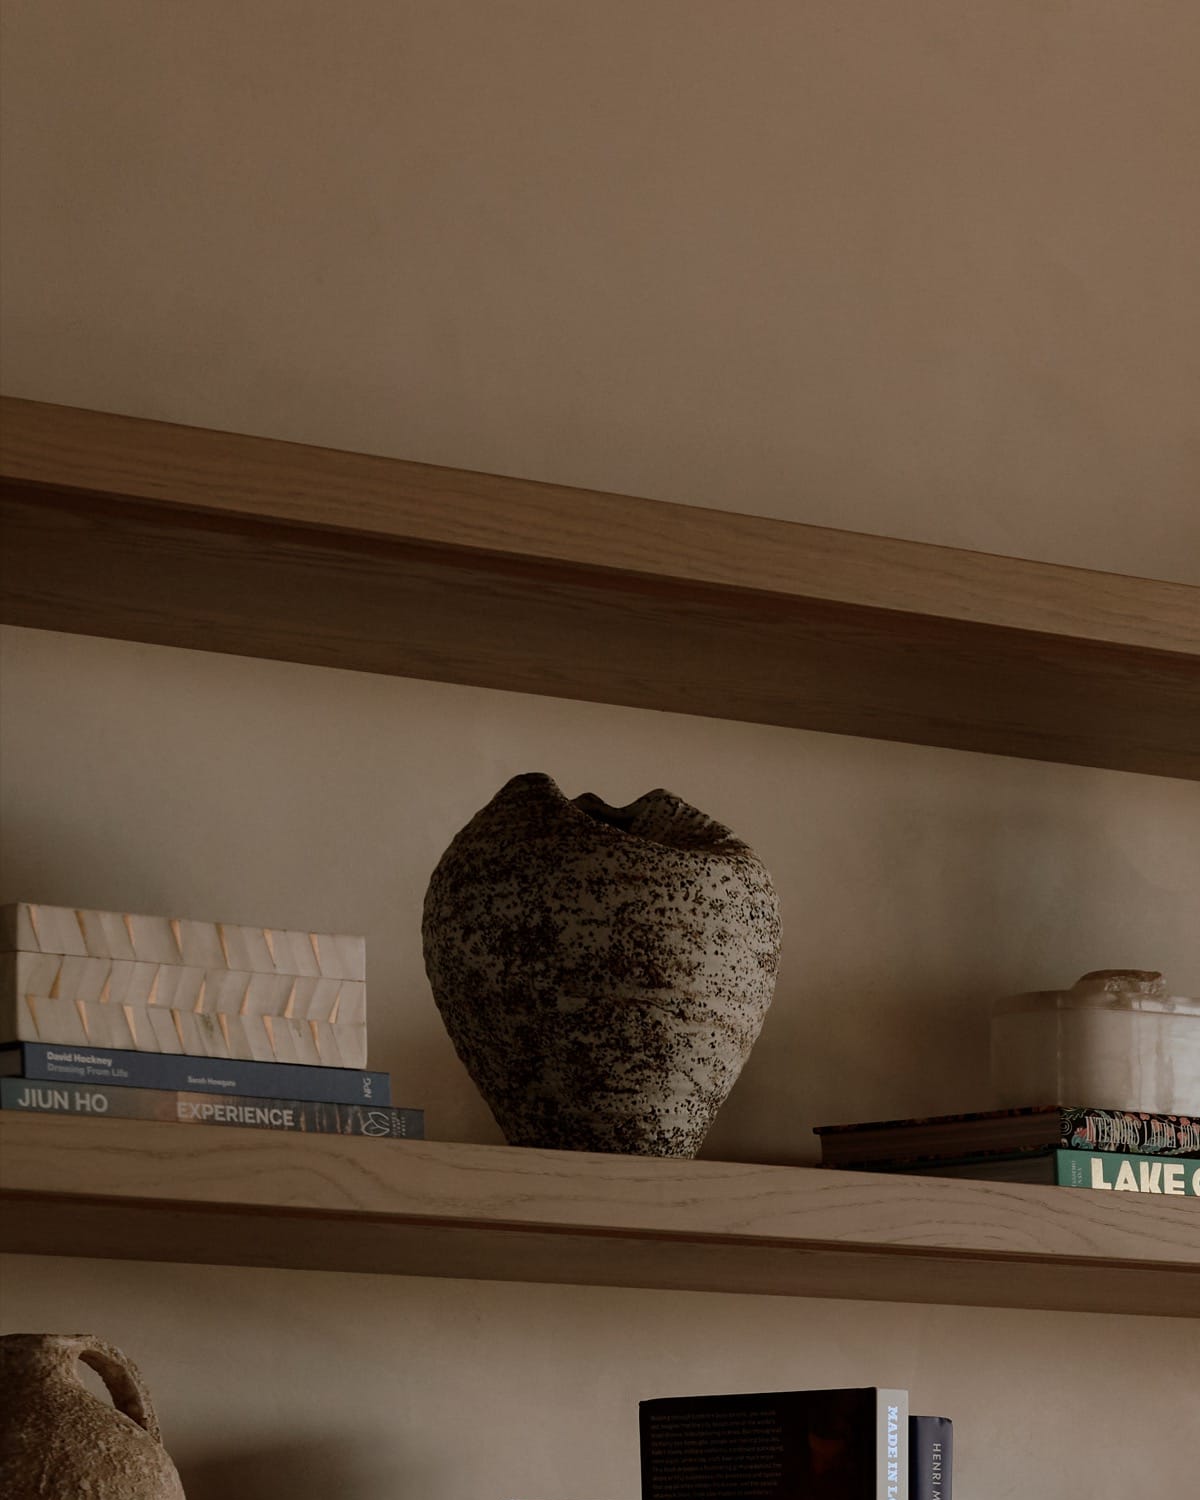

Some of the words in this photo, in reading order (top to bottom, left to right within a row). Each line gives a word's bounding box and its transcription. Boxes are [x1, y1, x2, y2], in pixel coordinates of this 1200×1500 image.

[47, 1051, 73, 1062] David
[74, 1053, 112, 1067] Hockney
[47, 1063, 85, 1076] Drawing
[86, 1066, 110, 1076] From
[111, 1067, 128, 1078] Life
[362, 1077, 372, 1098] NPG
[18, 1088, 69, 1110] JIUN
[75, 1092, 109, 1113] HO
[177, 1101, 295, 1127] EXPERIENCE
[1085, 1116, 1140, 1145] INTERIORS
[1142, 1120, 1176, 1148] LAURA
[1091, 1157, 1185, 1196] LAKE
[887, 1405, 898, 1458] MADE
[887, 1461, 898, 1483] IN
[932, 1443, 942, 1485] HENRI
